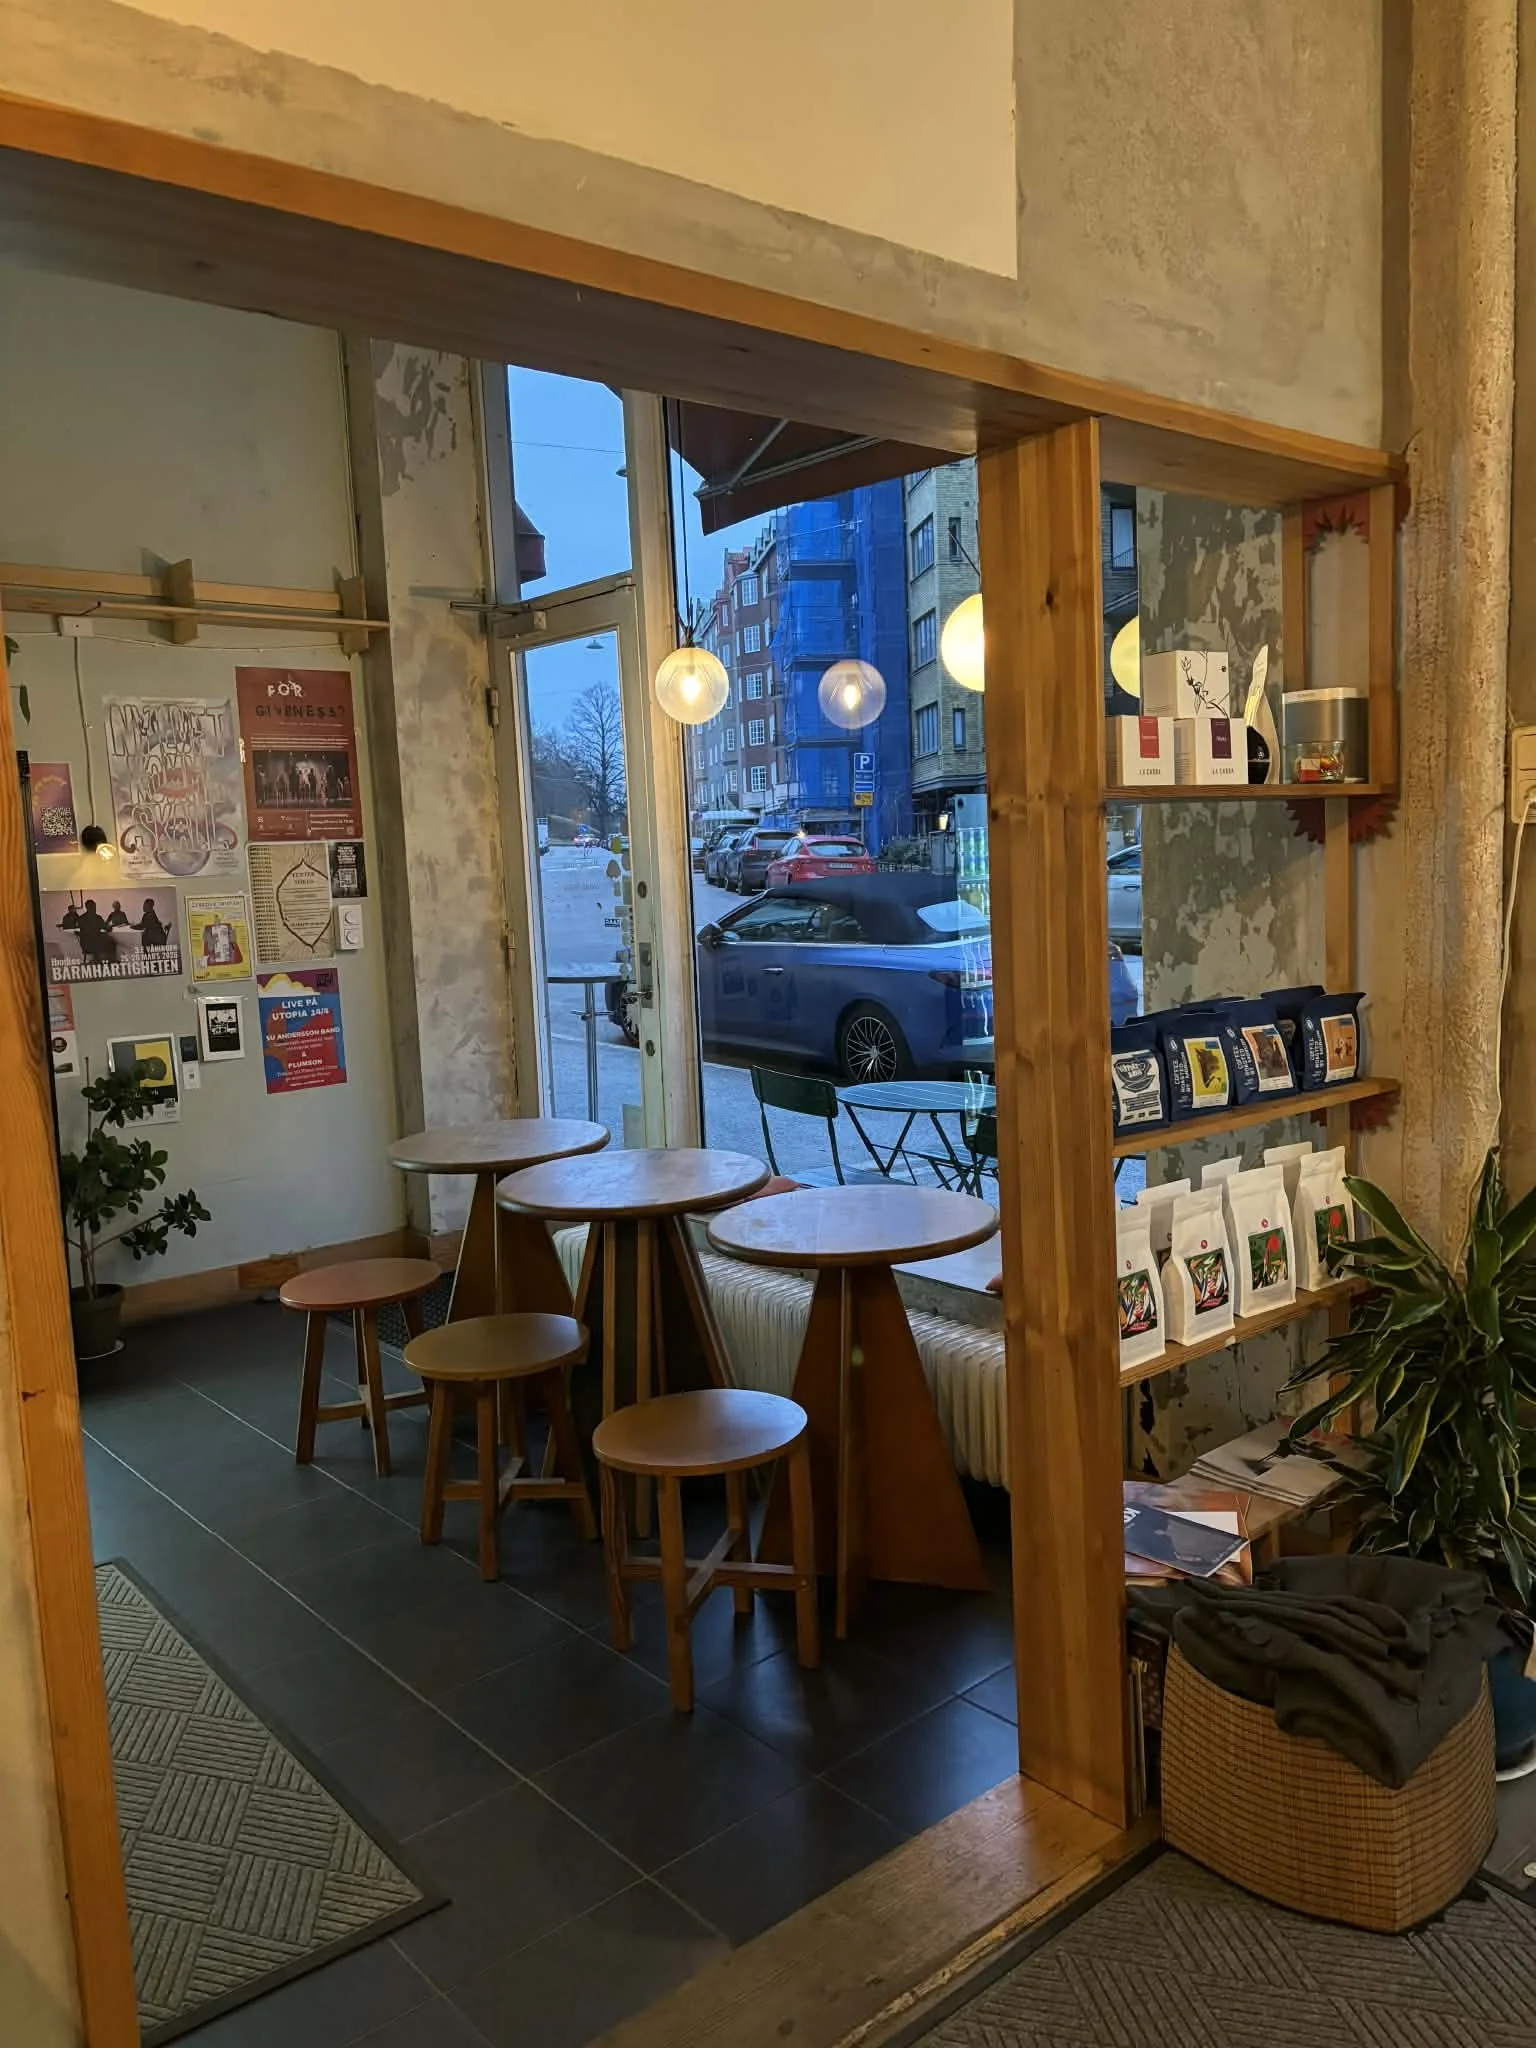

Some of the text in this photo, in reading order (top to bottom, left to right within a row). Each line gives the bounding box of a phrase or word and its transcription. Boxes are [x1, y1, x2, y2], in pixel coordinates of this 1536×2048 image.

[860, 755, 870, 769] P
[52, 959, 179, 981] BARMHÄRTIGHETEN
[282, 996, 318, 1008] LIVE PÅ
[272, 1011, 307, 1020] UTOPIA
[277, 1029, 320, 1040] ANDERSSON
[288, 1060, 322, 1068] PLUMSON
